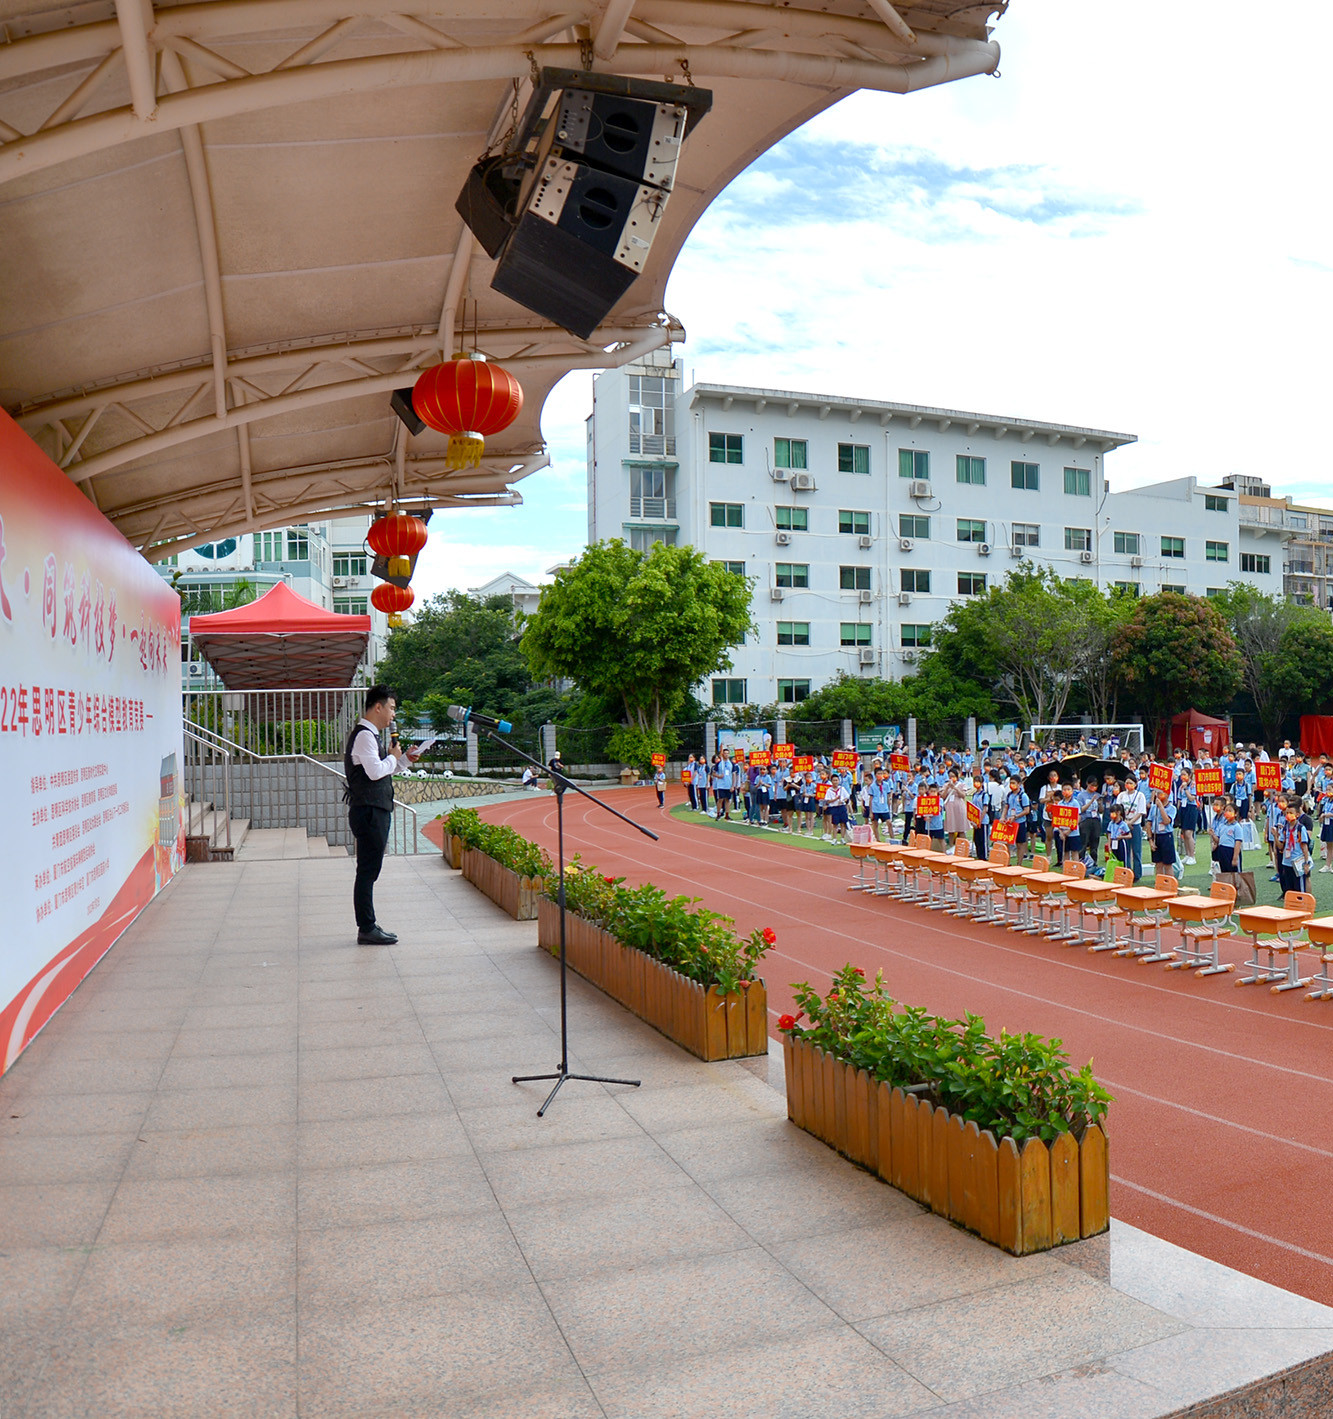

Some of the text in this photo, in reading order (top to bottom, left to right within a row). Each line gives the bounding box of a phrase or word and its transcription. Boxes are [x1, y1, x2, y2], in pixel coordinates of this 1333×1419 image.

[1153, 766, 1168, 779] 厦门市
[1260, 766, 1276, 776] 厦门市
